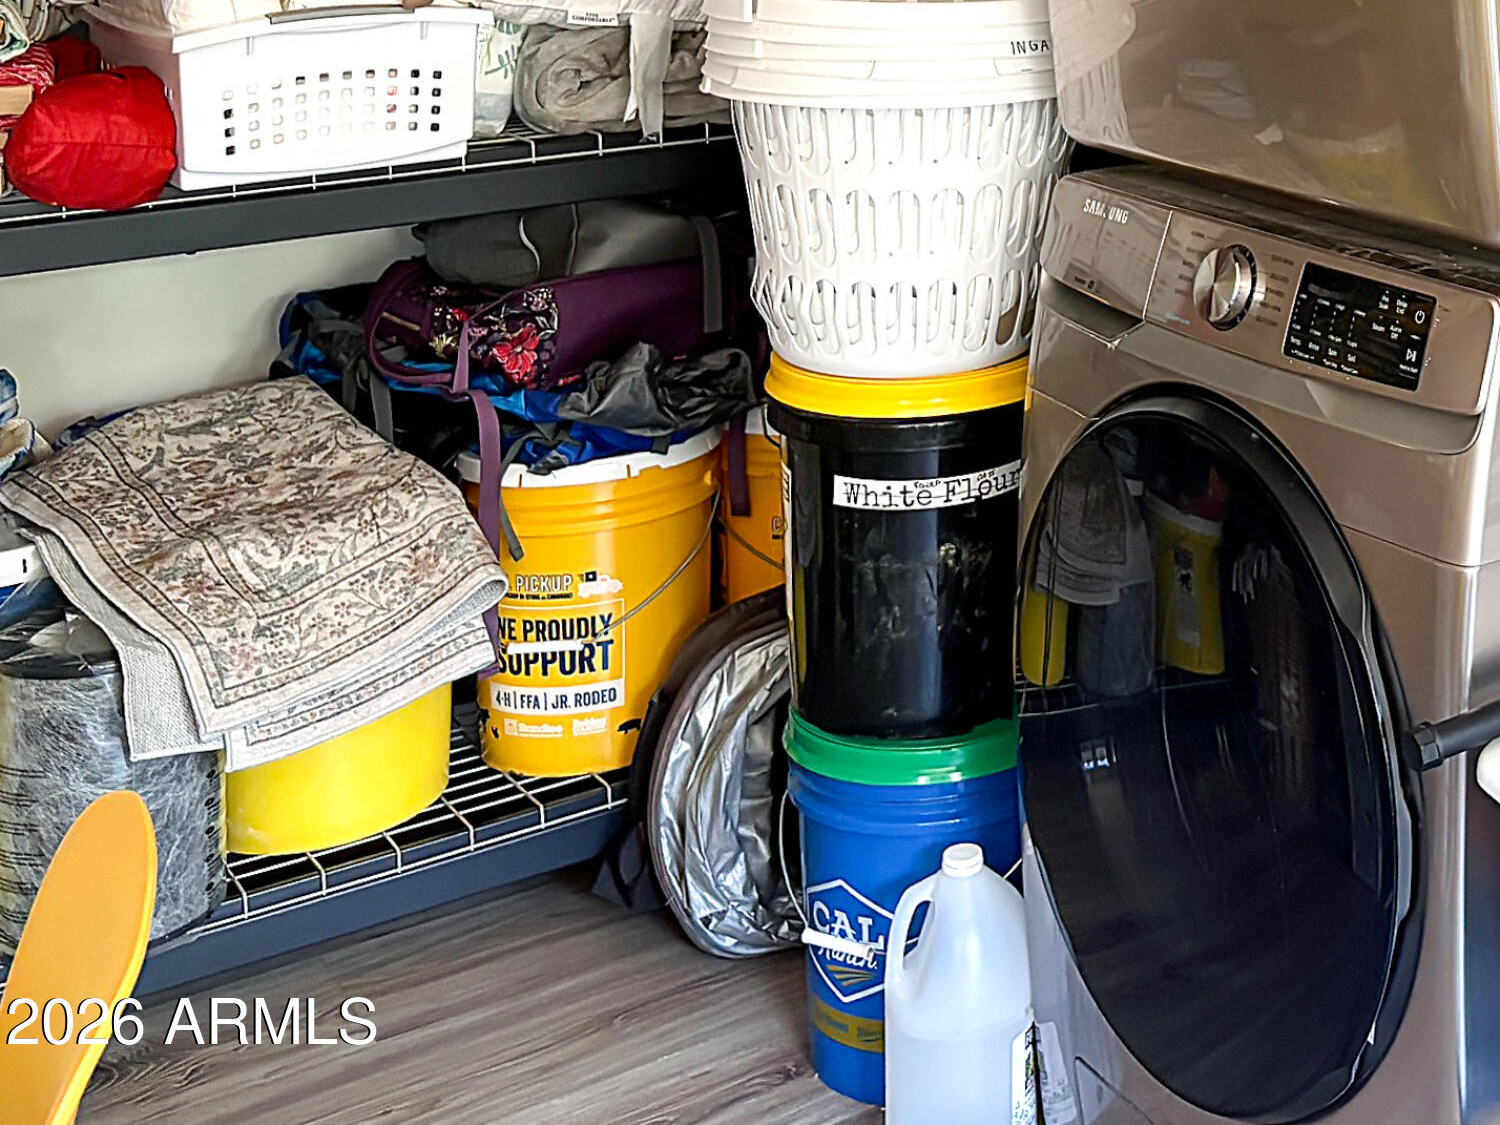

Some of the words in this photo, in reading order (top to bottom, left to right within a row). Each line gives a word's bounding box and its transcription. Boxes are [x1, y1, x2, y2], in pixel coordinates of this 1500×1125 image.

[1009, 39, 1050, 55] INGA
[842, 481, 932, 508] White
[943, 468, 1021, 503] Flour
[516, 574, 573, 592] PICKUP
[522, 613, 613, 642] PROUDLY
[499, 639, 614, 676] SUPPORT
[495, 690, 511, 708] 4-H
[520, 693, 541, 709] FFA
[551, 694, 571, 709] JR.
[574, 687, 617, 708] RODEO
[813, 900, 885, 951] CAL
